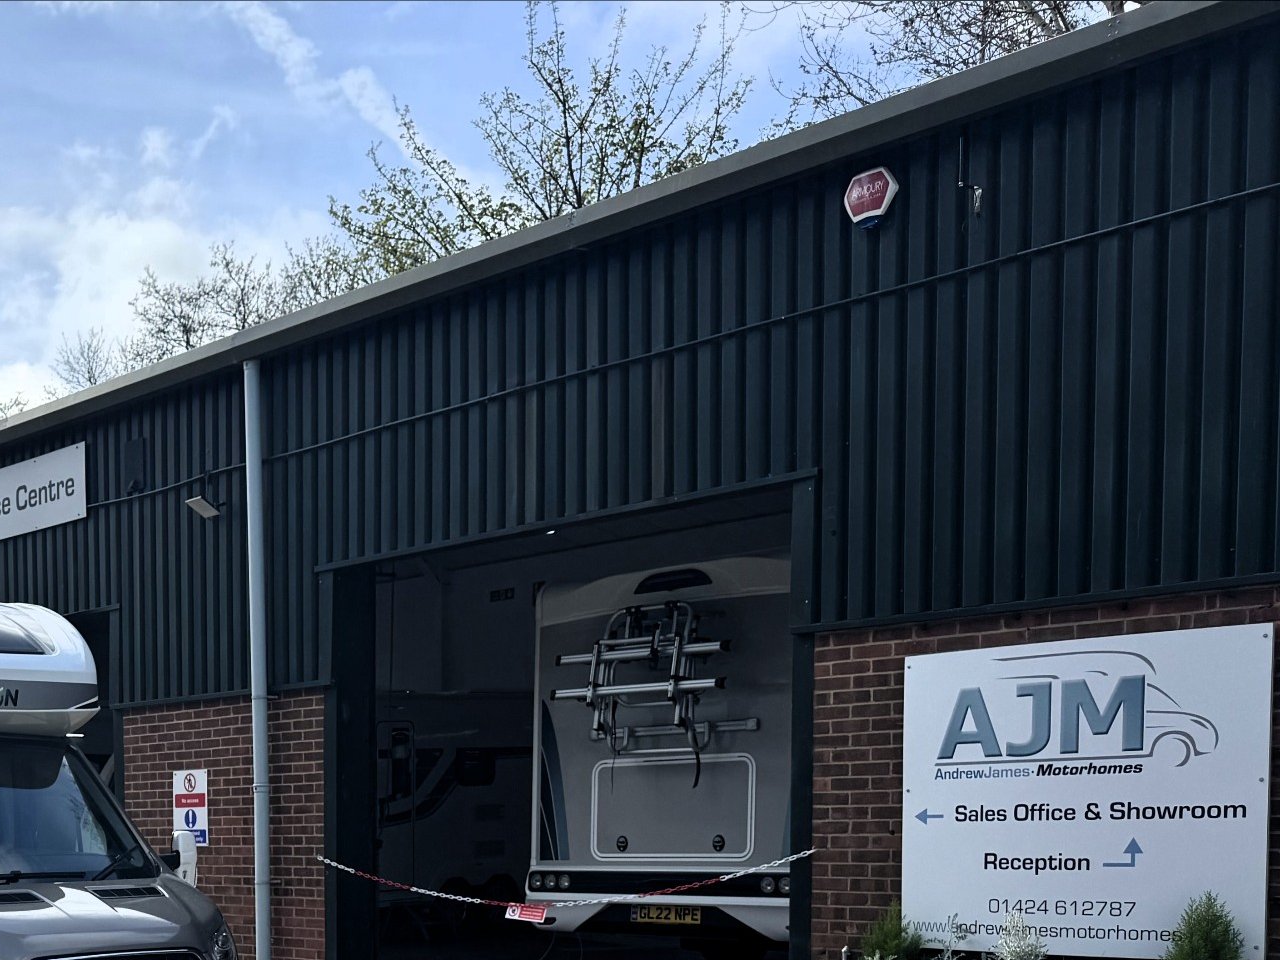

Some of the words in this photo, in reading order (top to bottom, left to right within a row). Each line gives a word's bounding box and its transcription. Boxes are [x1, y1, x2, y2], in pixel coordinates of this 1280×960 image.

[15, 477, 75, 511] Centre
[936, 674, 1145, 759] AJM
[954, 804, 1007, 822] Sales
[1013, 802, 1076, 821] Office
[1084, 803, 1102, 820] &
[1109, 801, 1247, 821] Showroom
[983, 852, 1090, 875] Reception
[639, 906, 671, 920] GL22
[674, 907, 699, 922] NPE
[988, 898, 1049, 914] 01424
[1055, 900, 1136, 917] 612787
